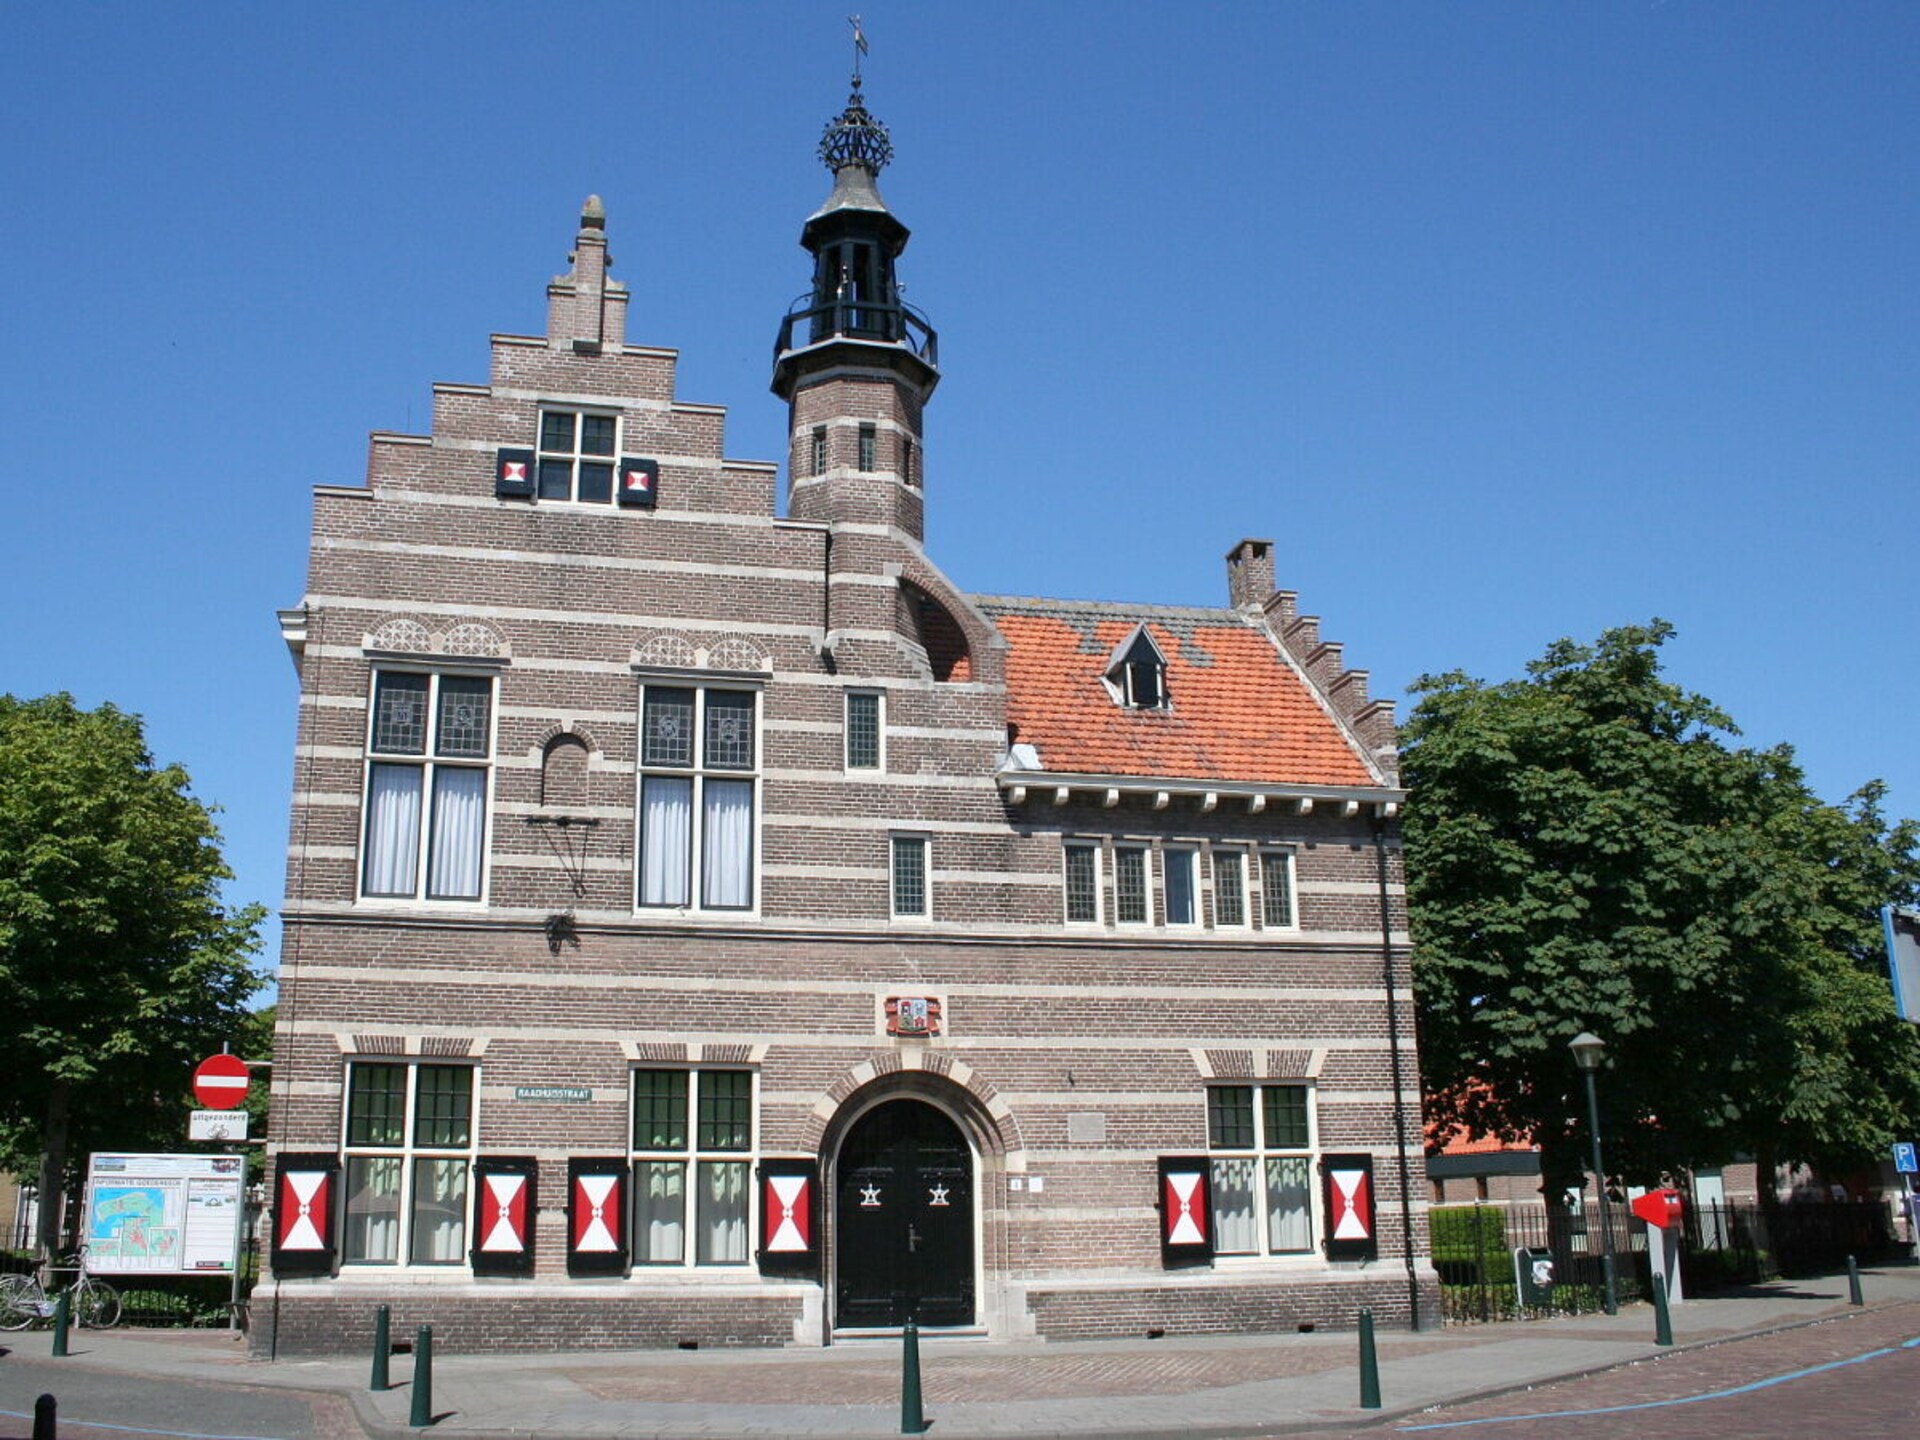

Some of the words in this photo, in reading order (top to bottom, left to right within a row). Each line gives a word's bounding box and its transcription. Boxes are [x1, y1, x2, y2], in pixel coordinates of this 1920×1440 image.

[518, 1089, 588, 1099] RAADHUISSTRAAT
[193, 1113, 246, 1121] uitgezonderd
[1899, 1147, 1909, 1160] P
